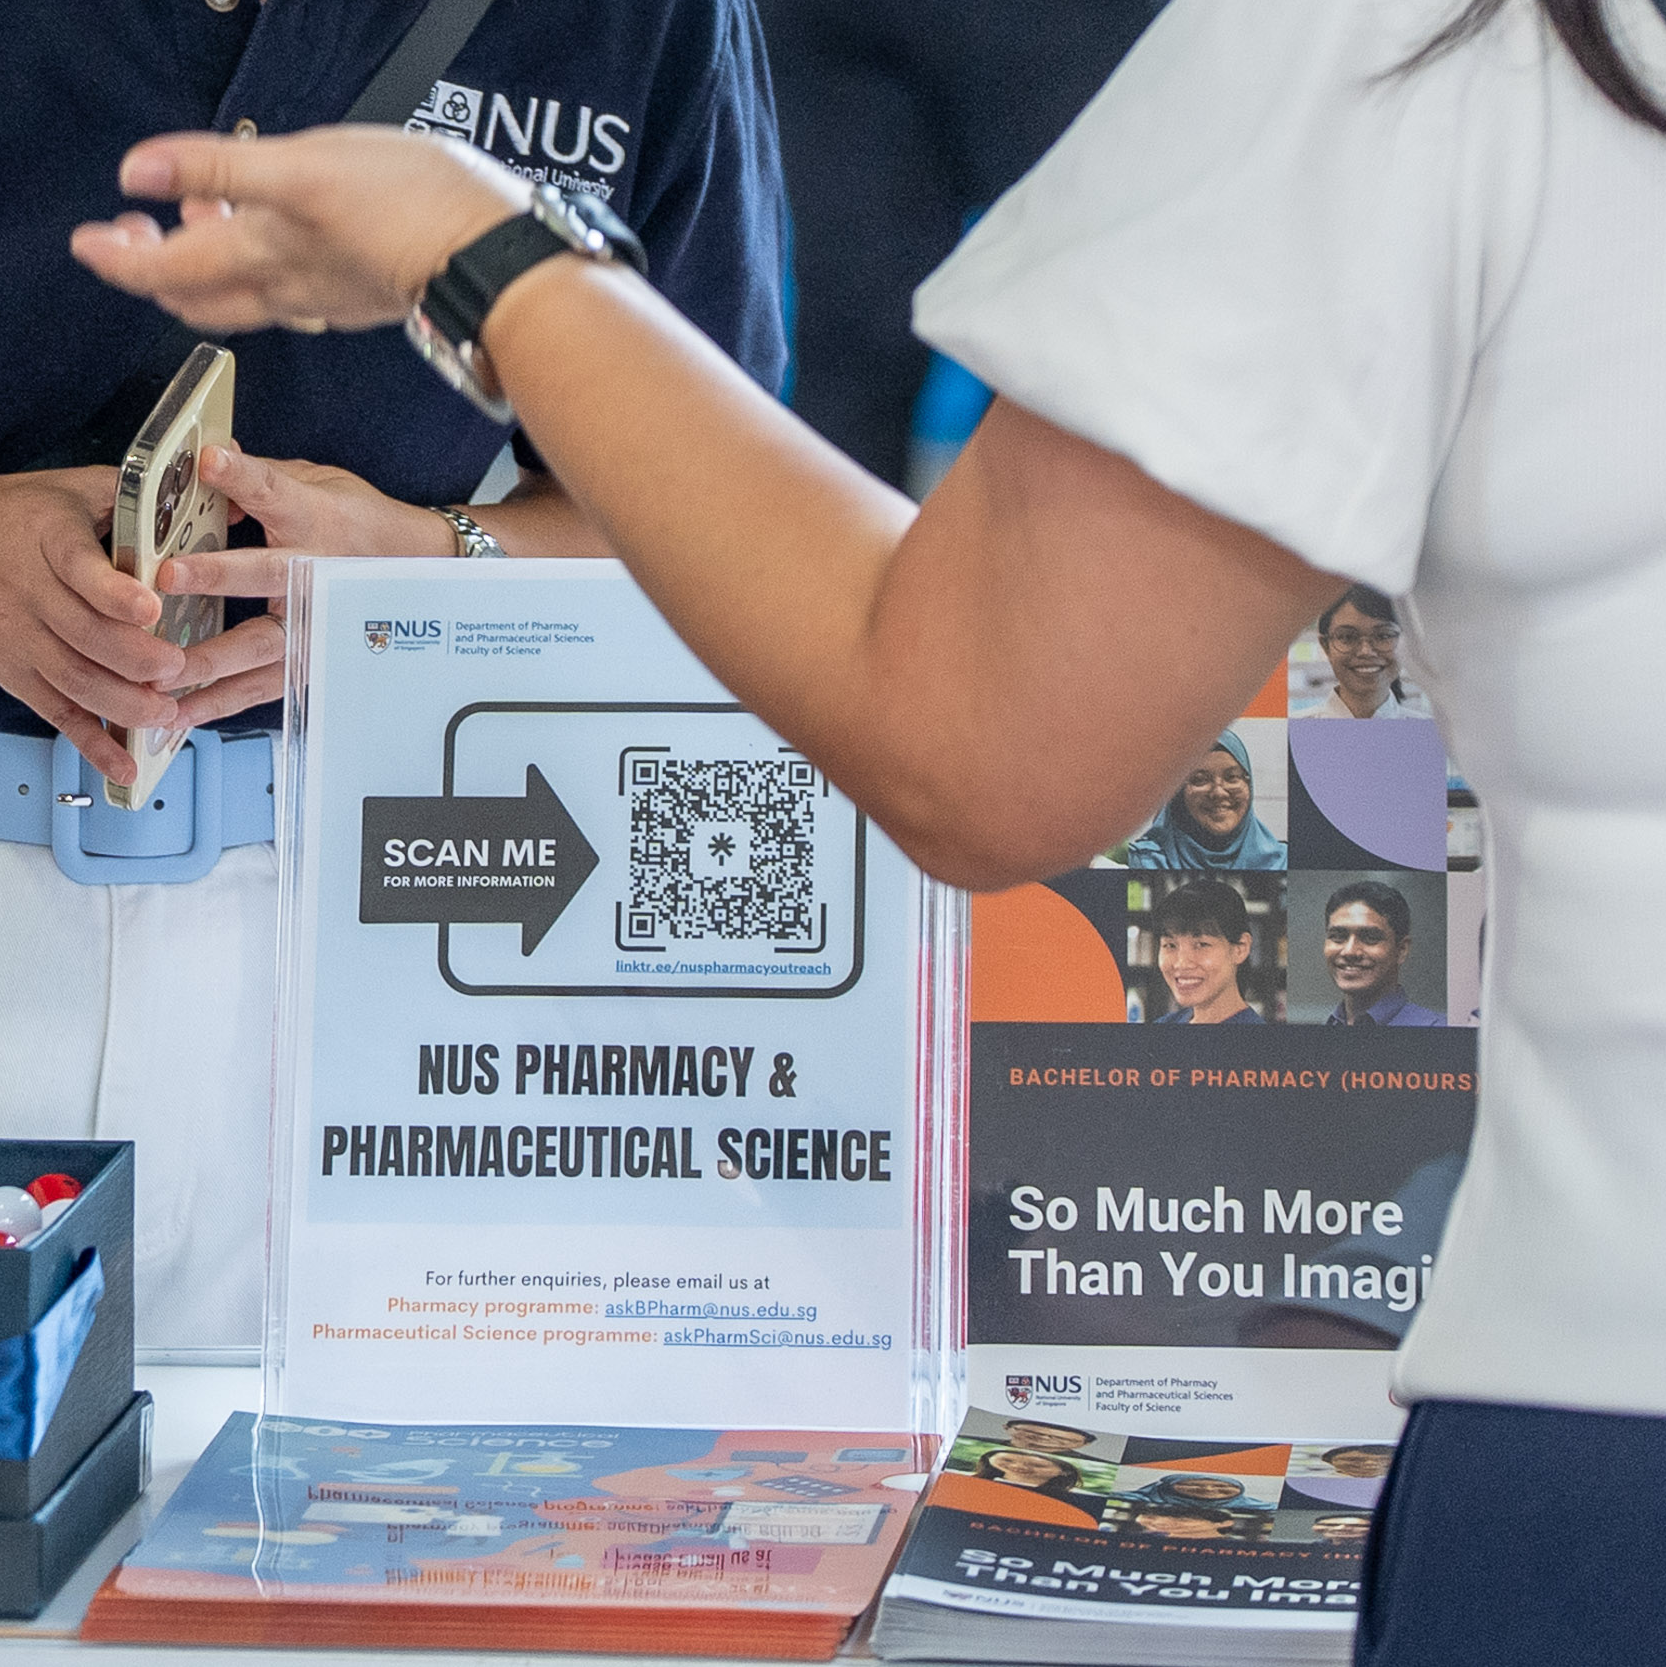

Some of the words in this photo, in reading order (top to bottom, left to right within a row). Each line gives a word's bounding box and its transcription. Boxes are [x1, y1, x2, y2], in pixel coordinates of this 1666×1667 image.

[484, 93, 630, 174] NUS
[551, 168, 615, 201] University
[394, 619, 441, 638] NUS
[455, 621, 517, 633] Department
[520, 621, 530, 631] of
[532, 621, 579, 633] Pharmacy
[455, 634, 474, 643] and
[477, 634, 551, 643] Pharmaceutical
[554, 634, 595, 644] Sciences
[455, 646, 489, 657] Faculty
[493, 645, 503, 655] of
[506, 646, 541, 655] Science
[384, 838, 489, 867] SCAN
[502, 839, 556, 867] ME
[383, 876, 410, 887] FOR
[414, 876, 454, 887] MORE
[457, 876, 555, 887] INFORMATION
[615, 960, 832, 975] linktr.ee/nuspharmacyoutreach
[419, 1044, 499, 1095] NUS
[516, 1045, 755, 1097] PHARMACY
[769, 1052, 797, 1098] &
[1009, 1068, 1140, 1087] BACHELOR
[1150, 1069, 1181, 1087] OF
[1191, 1069, 1331, 1089] PHARMACY
[322, 1125, 702, 1179] PHARMACEUTICAL
[717, 1128, 892, 1182] SCIENCE
[1009, 1185, 1078, 1233] So
[1096, 1185, 1244, 1233] Much
[1263, 1189, 1403, 1236] More
[426, 1270, 452, 1286] For
[458, 1270, 515, 1287] further
[521, 1272, 607, 1291] enquiries,
[614, 1272, 670, 1292] please
[676, 1274, 723, 1289] email
[729, 1278, 748, 1290] us
[754, 1276, 770, 1290] at
[1008, 1248, 1143, 1296] Than
[1160, 1251, 1263, 1297] You
[1283, 1253, 1433, 1313] Imagi
[388, 1297, 479, 1318] Pharmacy
[485, 1302, 599, 1318] programme:
[605, 1300, 817, 1321] askBPharm@nus.edu.sg
[312, 1323, 457, 1340] Pharmaceutical
[463, 1325, 537, 1341] Science
[543, 1327, 658, 1345] programme:
[663, 1328, 892, 1350] askPharmSci@nus.edu.sg
[1035, 1375, 1082, 1393] NUS
[1095, 1377, 1155, 1388] Department
[1157, 1377, 1167, 1387] of
[1171, 1378, 1218, 1389] Pharmacy
[1095, 1390, 1115, 1399] and
[1117, 1390, 1191, 1400] Pharmaceutical
[1193, 1391, 1234, 1401] Sciences
[1095, 1402, 1129, 1413] Faculty
[1132, 1402, 1143, 1412] of
[1145, 1403, 1181, 1413] Science
[401, 1436, 615, 1448] Science
[959, 1548, 1034, 1569] So
[1052, 1560, 1213, 1586] Much
[955, 1560, 1100, 1593] Than
[1119, 1581, 1230, 1601] You
[1249, 1589, 1358, 1605] Ima
